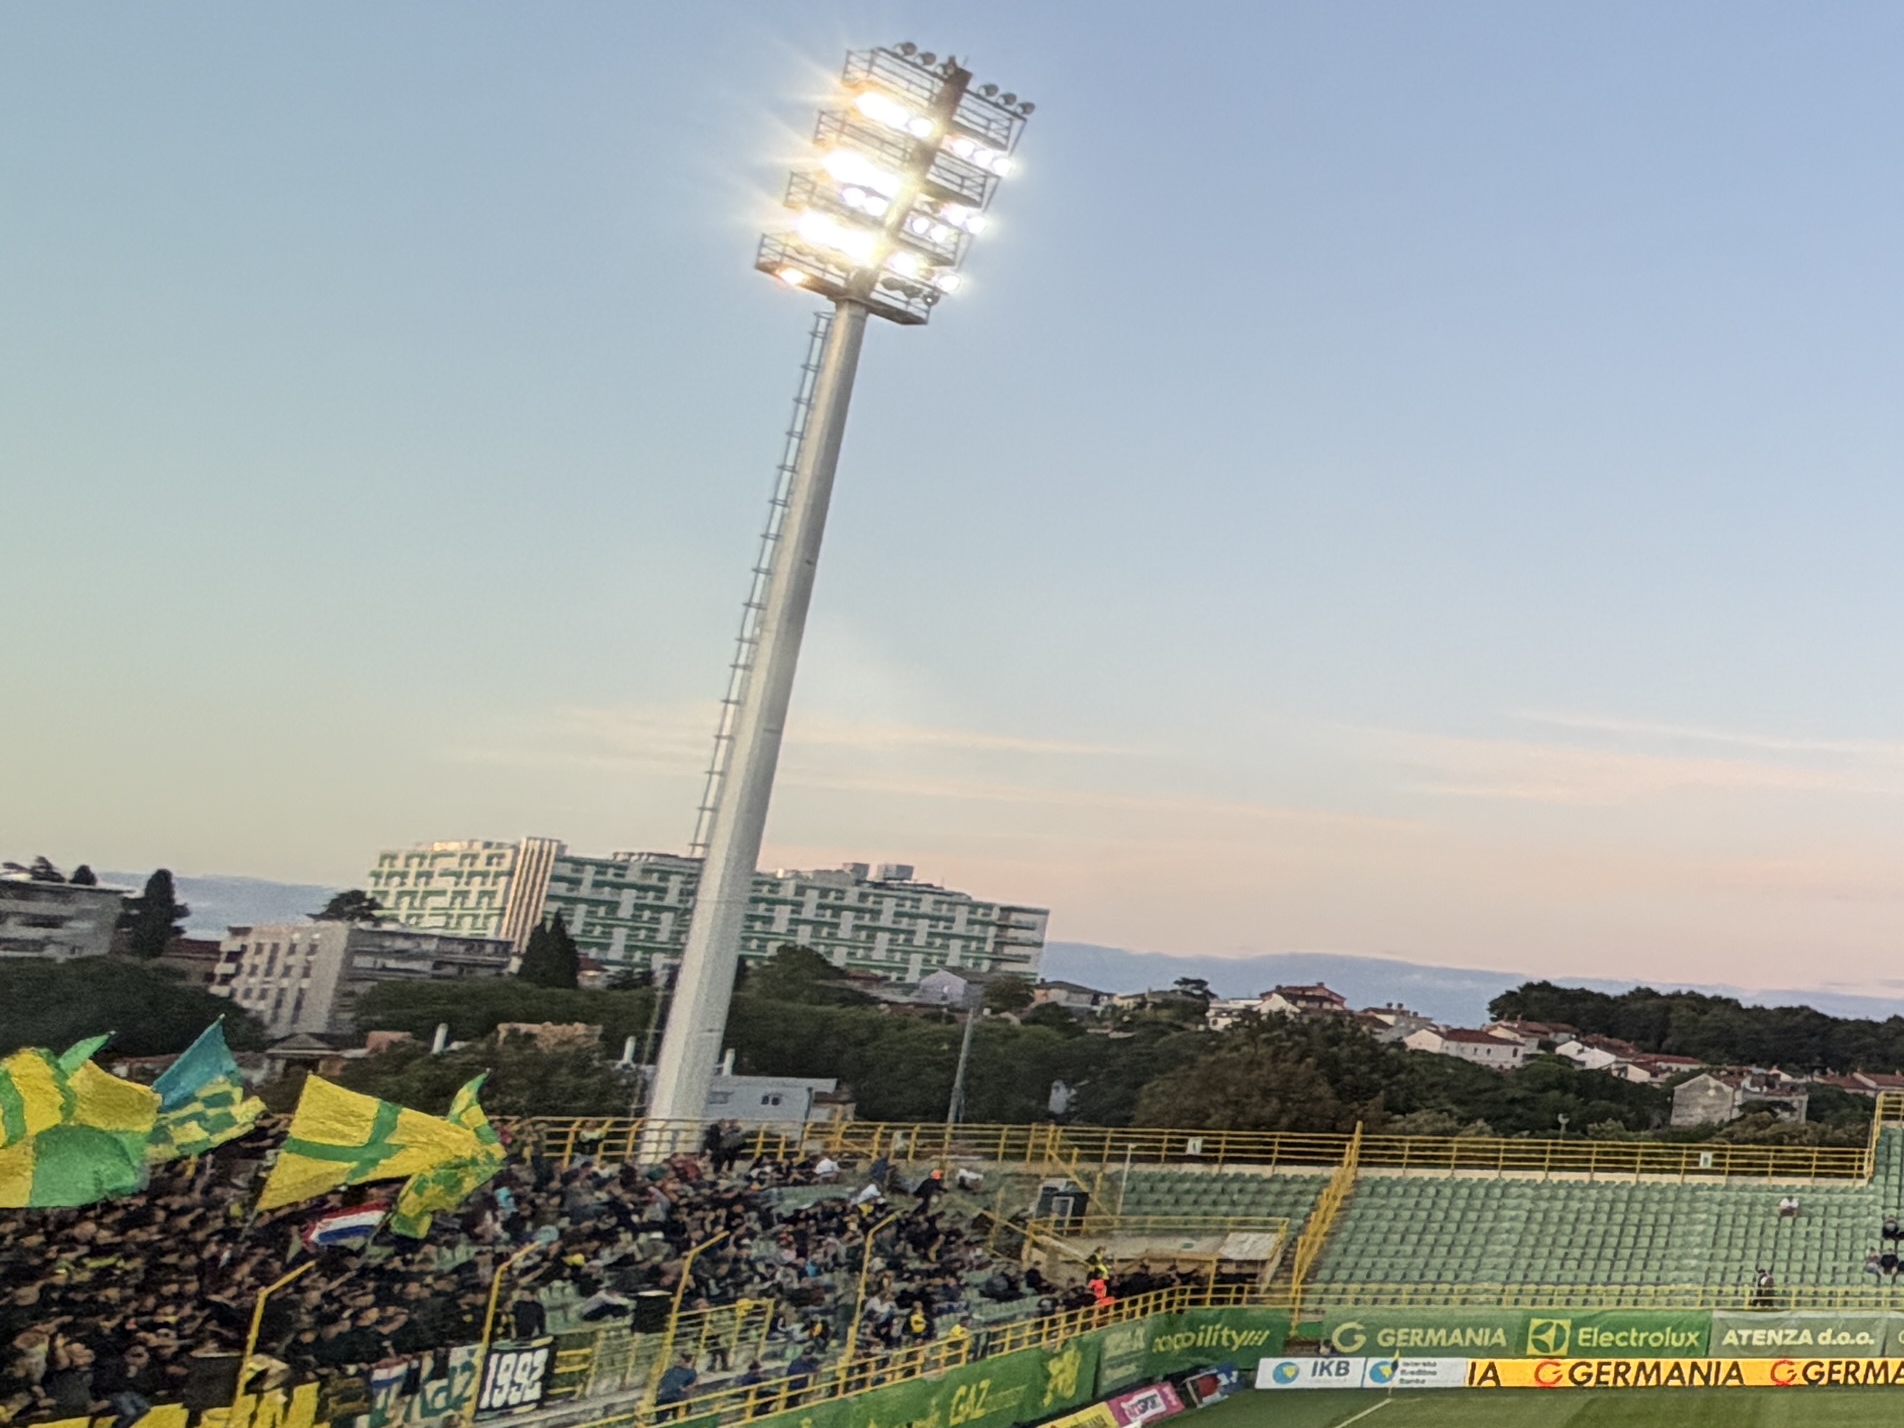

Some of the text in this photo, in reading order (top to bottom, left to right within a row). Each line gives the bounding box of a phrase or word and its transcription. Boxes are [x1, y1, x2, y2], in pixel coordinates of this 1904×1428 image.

[1376, 1326, 1507, 1348] GERMANIA
[1577, 1326, 1700, 1348] Electrolux
[1721, 1327, 1875, 1346] ATENZA d.o.o.
[478, 1346, 549, 1411] 1992
[1311, 1360, 1351, 1378] IKB
[1468, 1360, 1502, 1387] IA
[1568, 1360, 1745, 1387] GERMANIA
